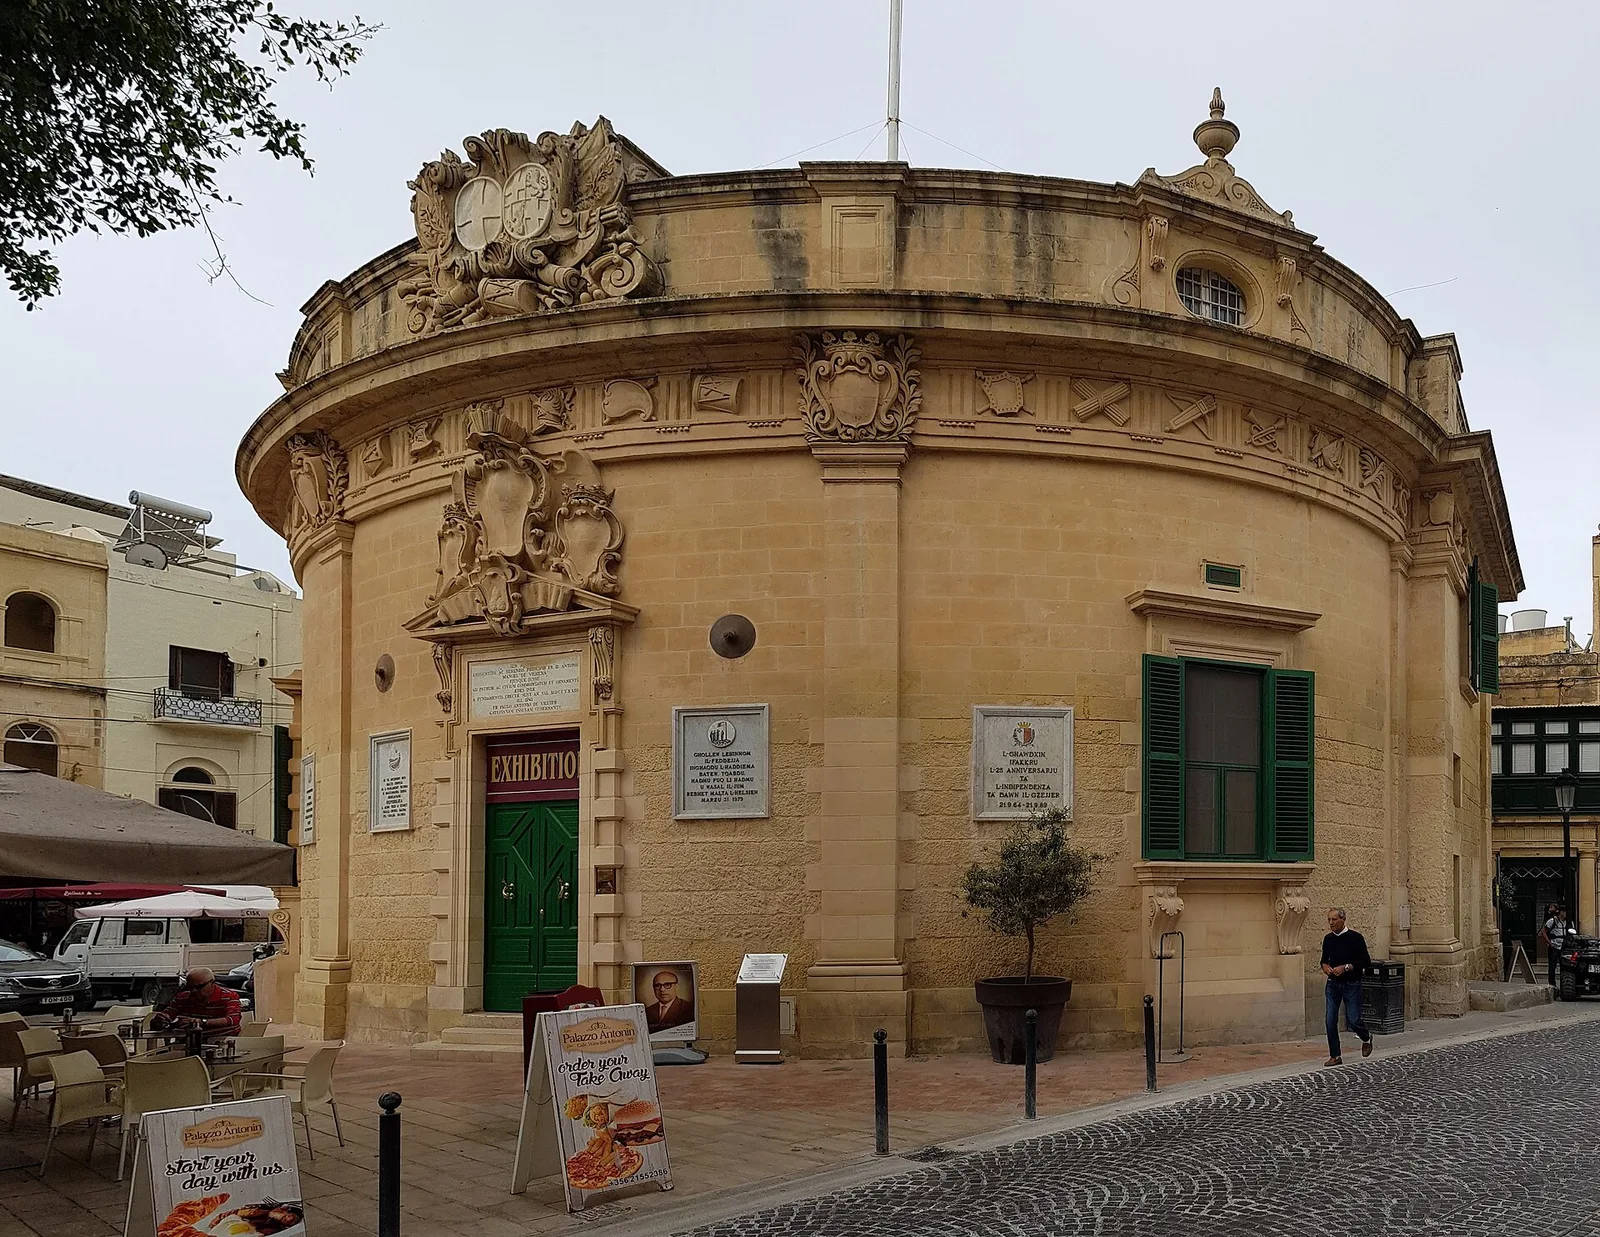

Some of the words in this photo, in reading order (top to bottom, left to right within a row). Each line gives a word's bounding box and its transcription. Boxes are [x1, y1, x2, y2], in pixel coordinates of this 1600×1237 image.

[562, 1032, 598, 1044] Palazzo
[600, 1028, 636, 1040] Antonin
[558, 1057, 596, 1074] order
[599, 1054, 629, 1072] your
[570, 1070, 605, 1087] Take
[610, 1066, 650, 1083] Away
[184, 1130, 222, 1142] Palazzo
[224, 1123, 262, 1136] Antonin
[166, 1156, 216, 1176] start
[214, 1152, 257, 1173] your
[182, 1174, 220, 1192] day
[222, 1164, 258, 1183] with
